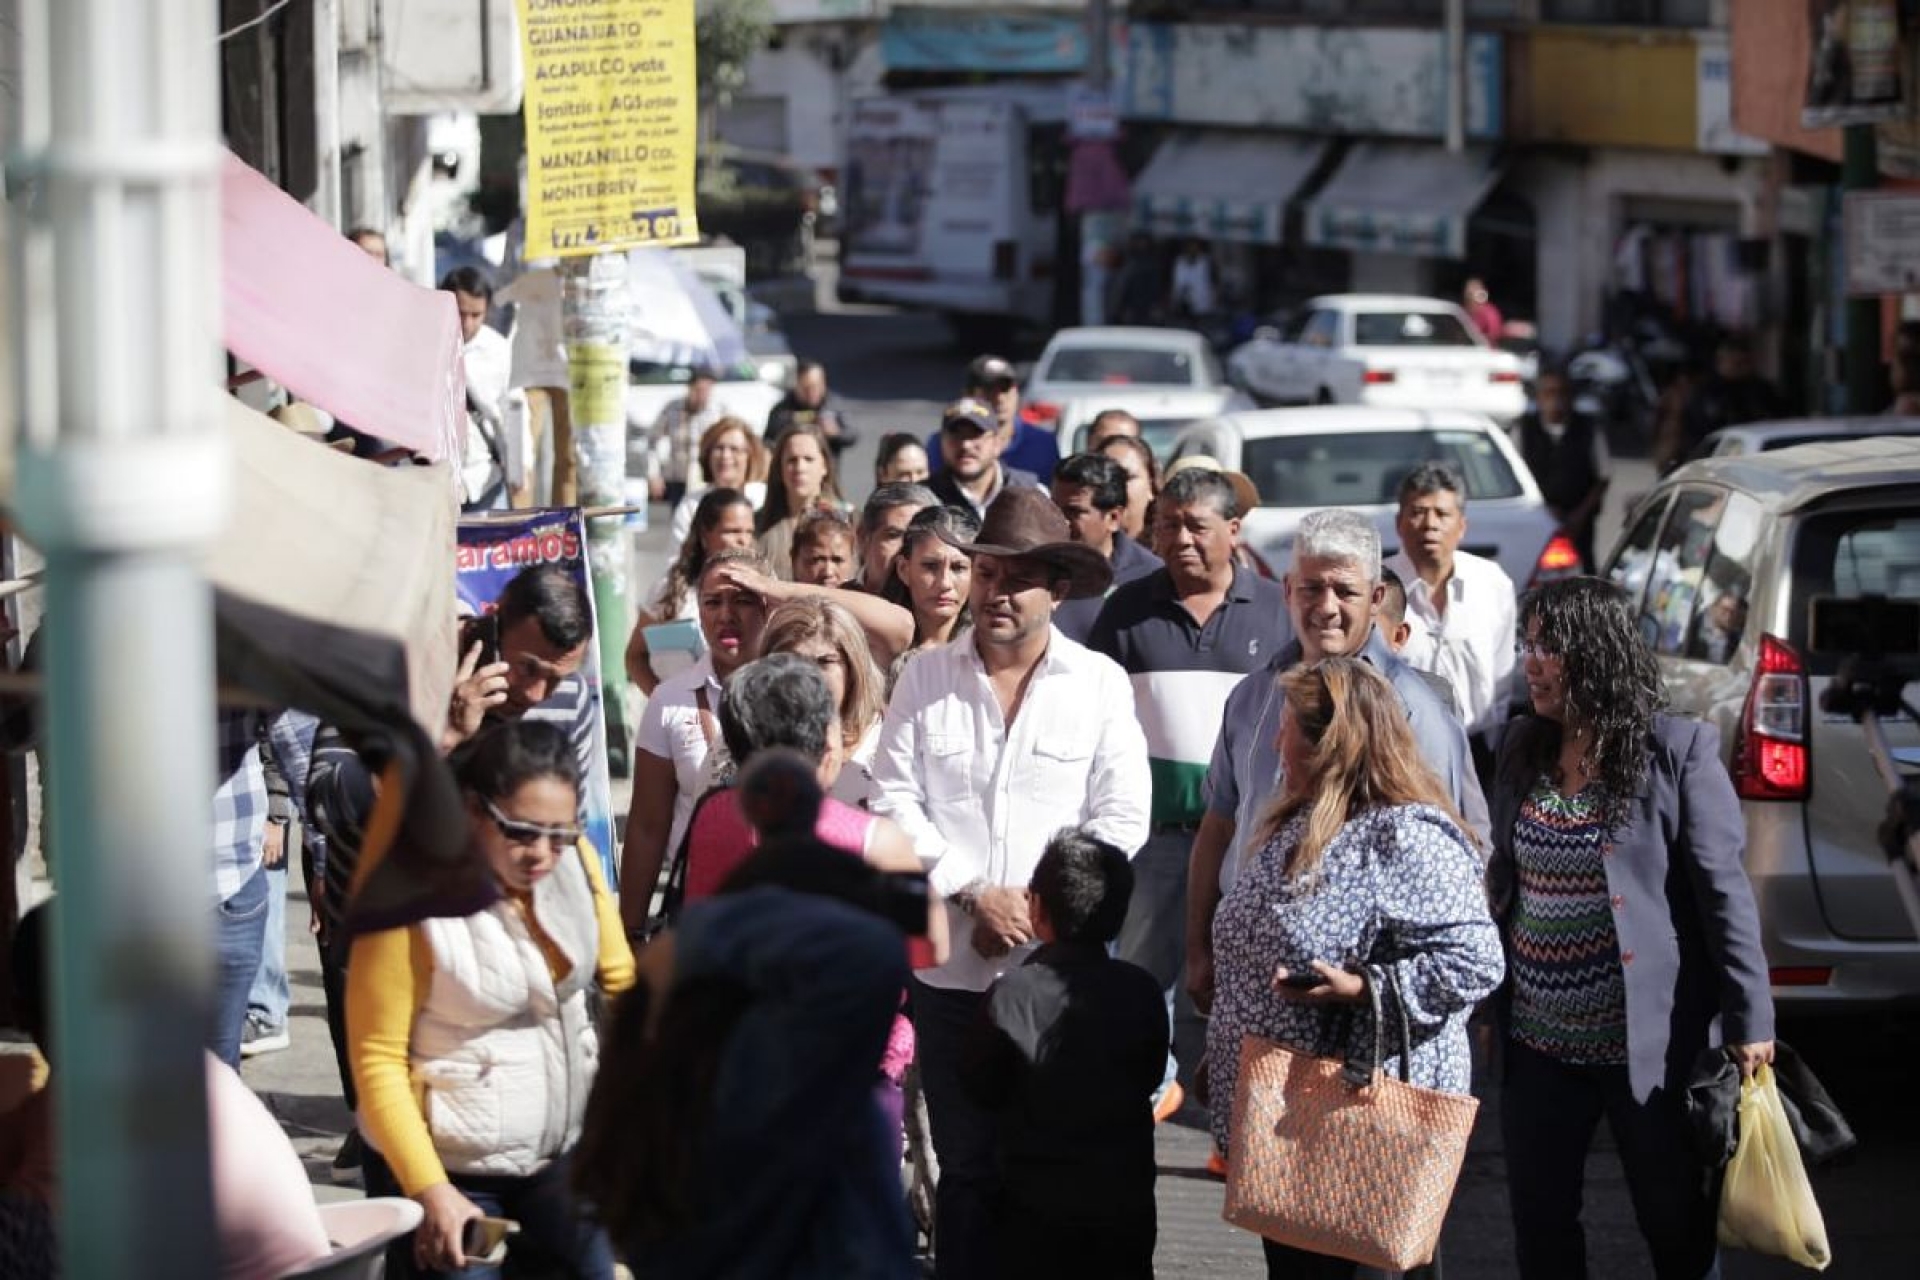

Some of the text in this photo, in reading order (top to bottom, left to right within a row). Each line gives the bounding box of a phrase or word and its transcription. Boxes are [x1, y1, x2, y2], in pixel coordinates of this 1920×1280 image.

[528, 23, 641, 46] GUANAJUATO
[535, 58, 624, 80] ACAPULCO
[541, 145, 648, 170] MANZANILLO
[541, 180, 636, 203] MONTERREY
